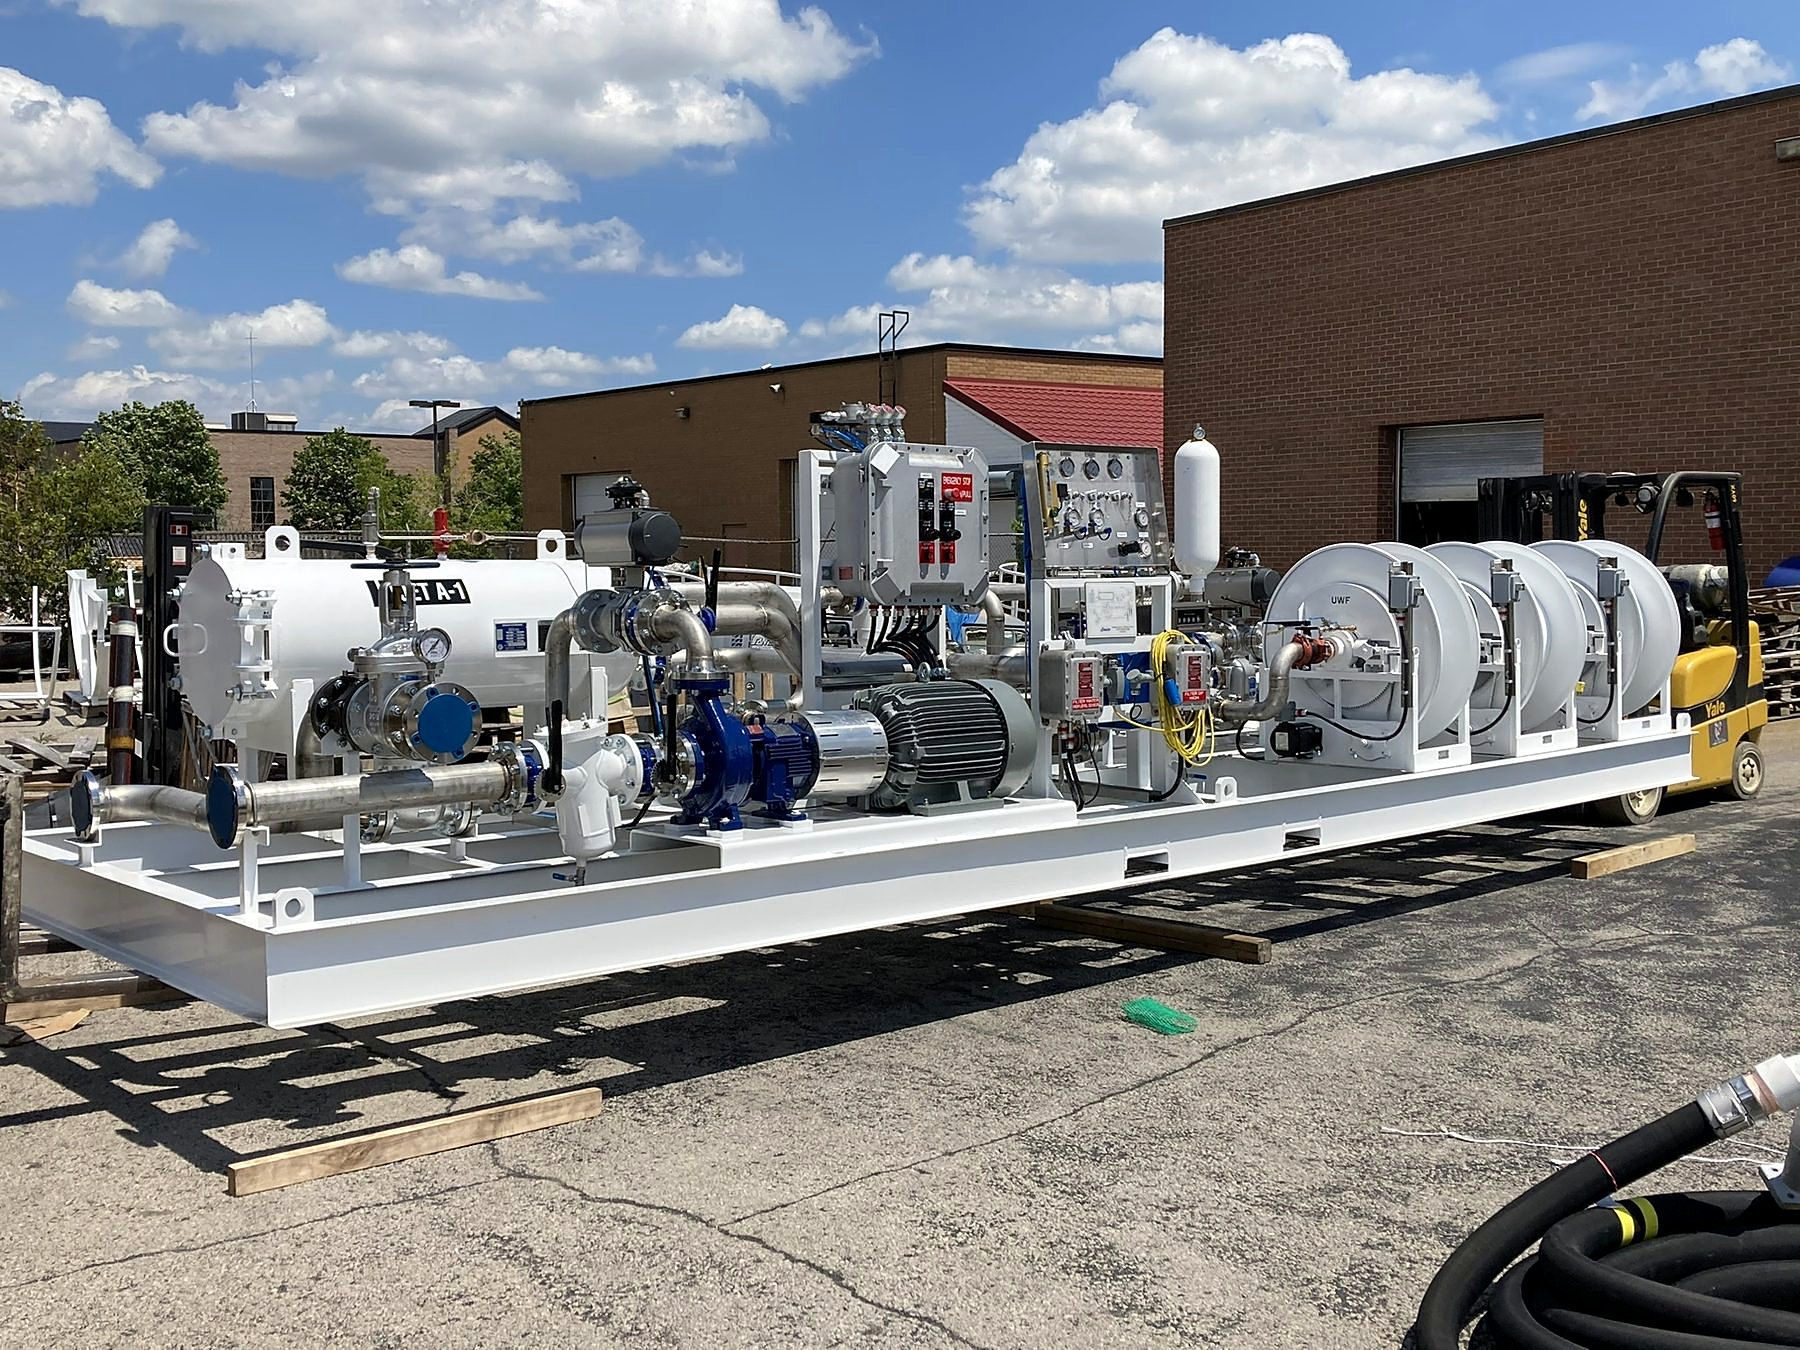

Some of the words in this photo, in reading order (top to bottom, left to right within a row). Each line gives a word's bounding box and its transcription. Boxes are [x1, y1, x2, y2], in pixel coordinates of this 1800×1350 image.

[1578, 499, 1588, 541] Yale
[435, 582, 467, 601] A-1
[1331, 596, 1351, 604] UWF
[1705, 700, 1726, 718] Yale
